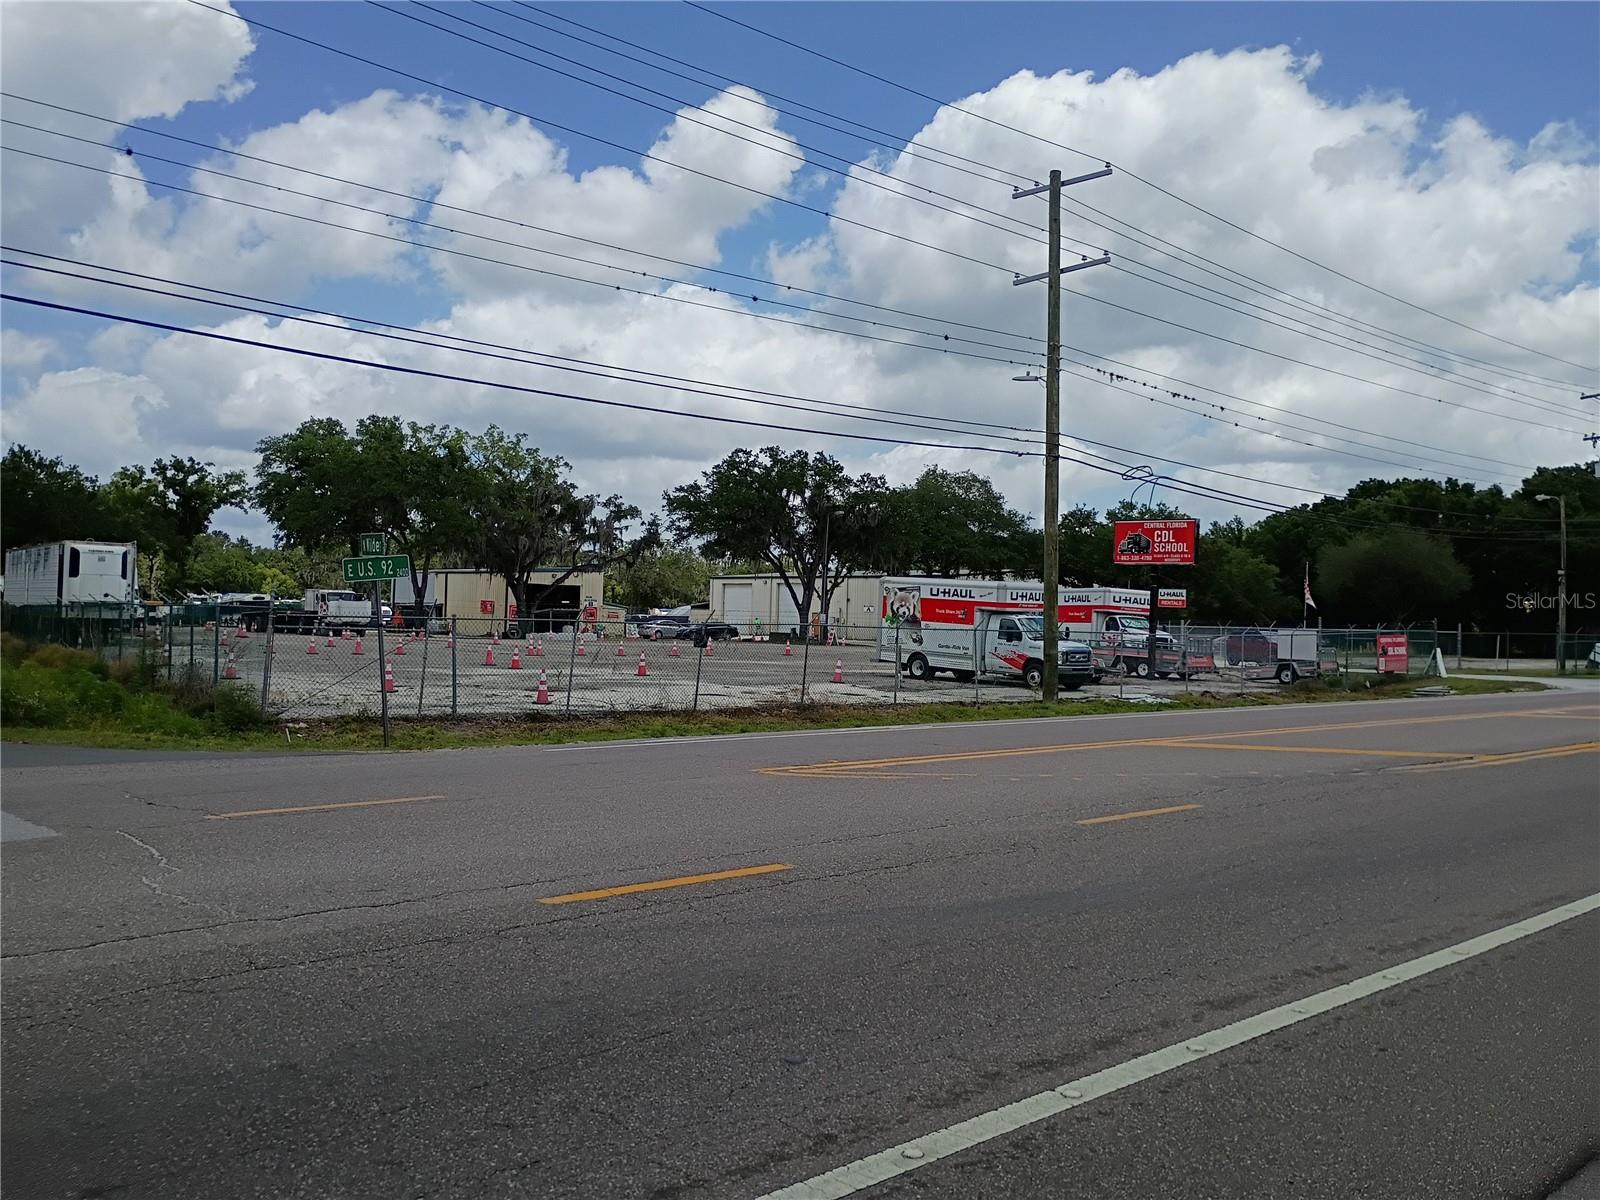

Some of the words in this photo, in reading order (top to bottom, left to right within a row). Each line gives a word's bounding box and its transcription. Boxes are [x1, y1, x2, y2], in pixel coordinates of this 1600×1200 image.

[1154, 530, 1175, 542] CDL
[1154, 543, 1188, 552] SCHOOL
[348, 564, 354, 577] E
[358, 560, 377, 577] U.S.
[381, 560, 393, 575] 92
[930, 587, 976, 599] U-HAUL
[1063, 594, 1091, 603] U-HAUL
